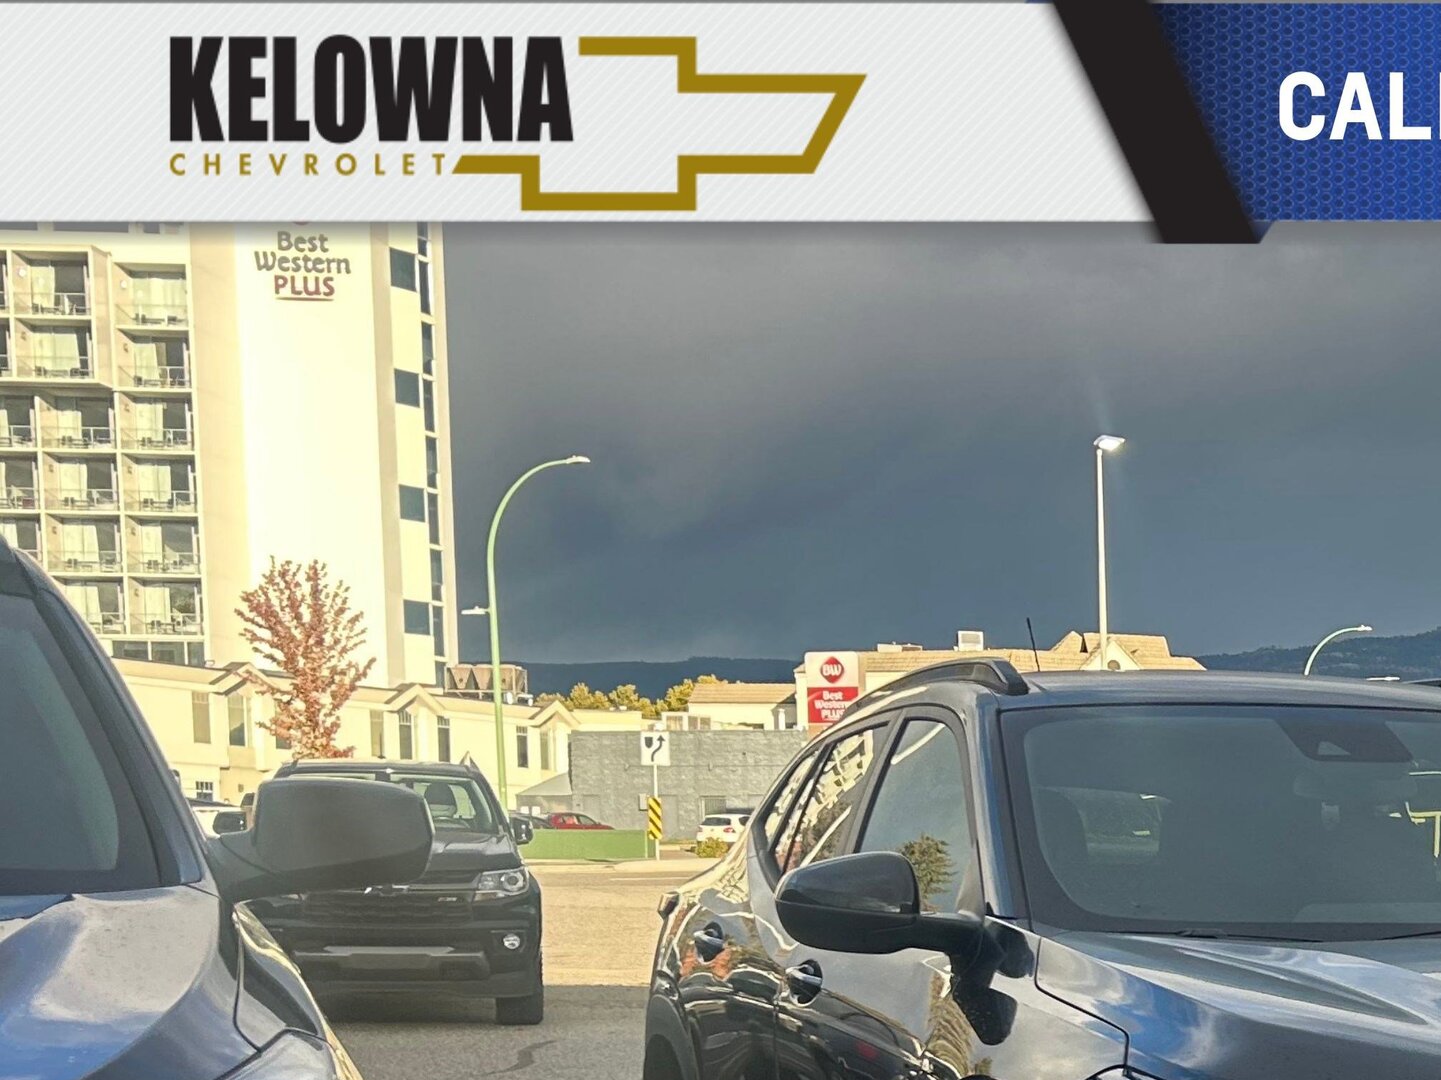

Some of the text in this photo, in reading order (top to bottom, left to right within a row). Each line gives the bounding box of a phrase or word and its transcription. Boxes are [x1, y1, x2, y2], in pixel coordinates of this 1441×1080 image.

[277, 230, 329, 253] Best
[254, 250, 351, 274] Western
[274, 274, 335, 297] PLUS
[822, 663, 842, 676] BW
[822, 690, 844, 701] Best
